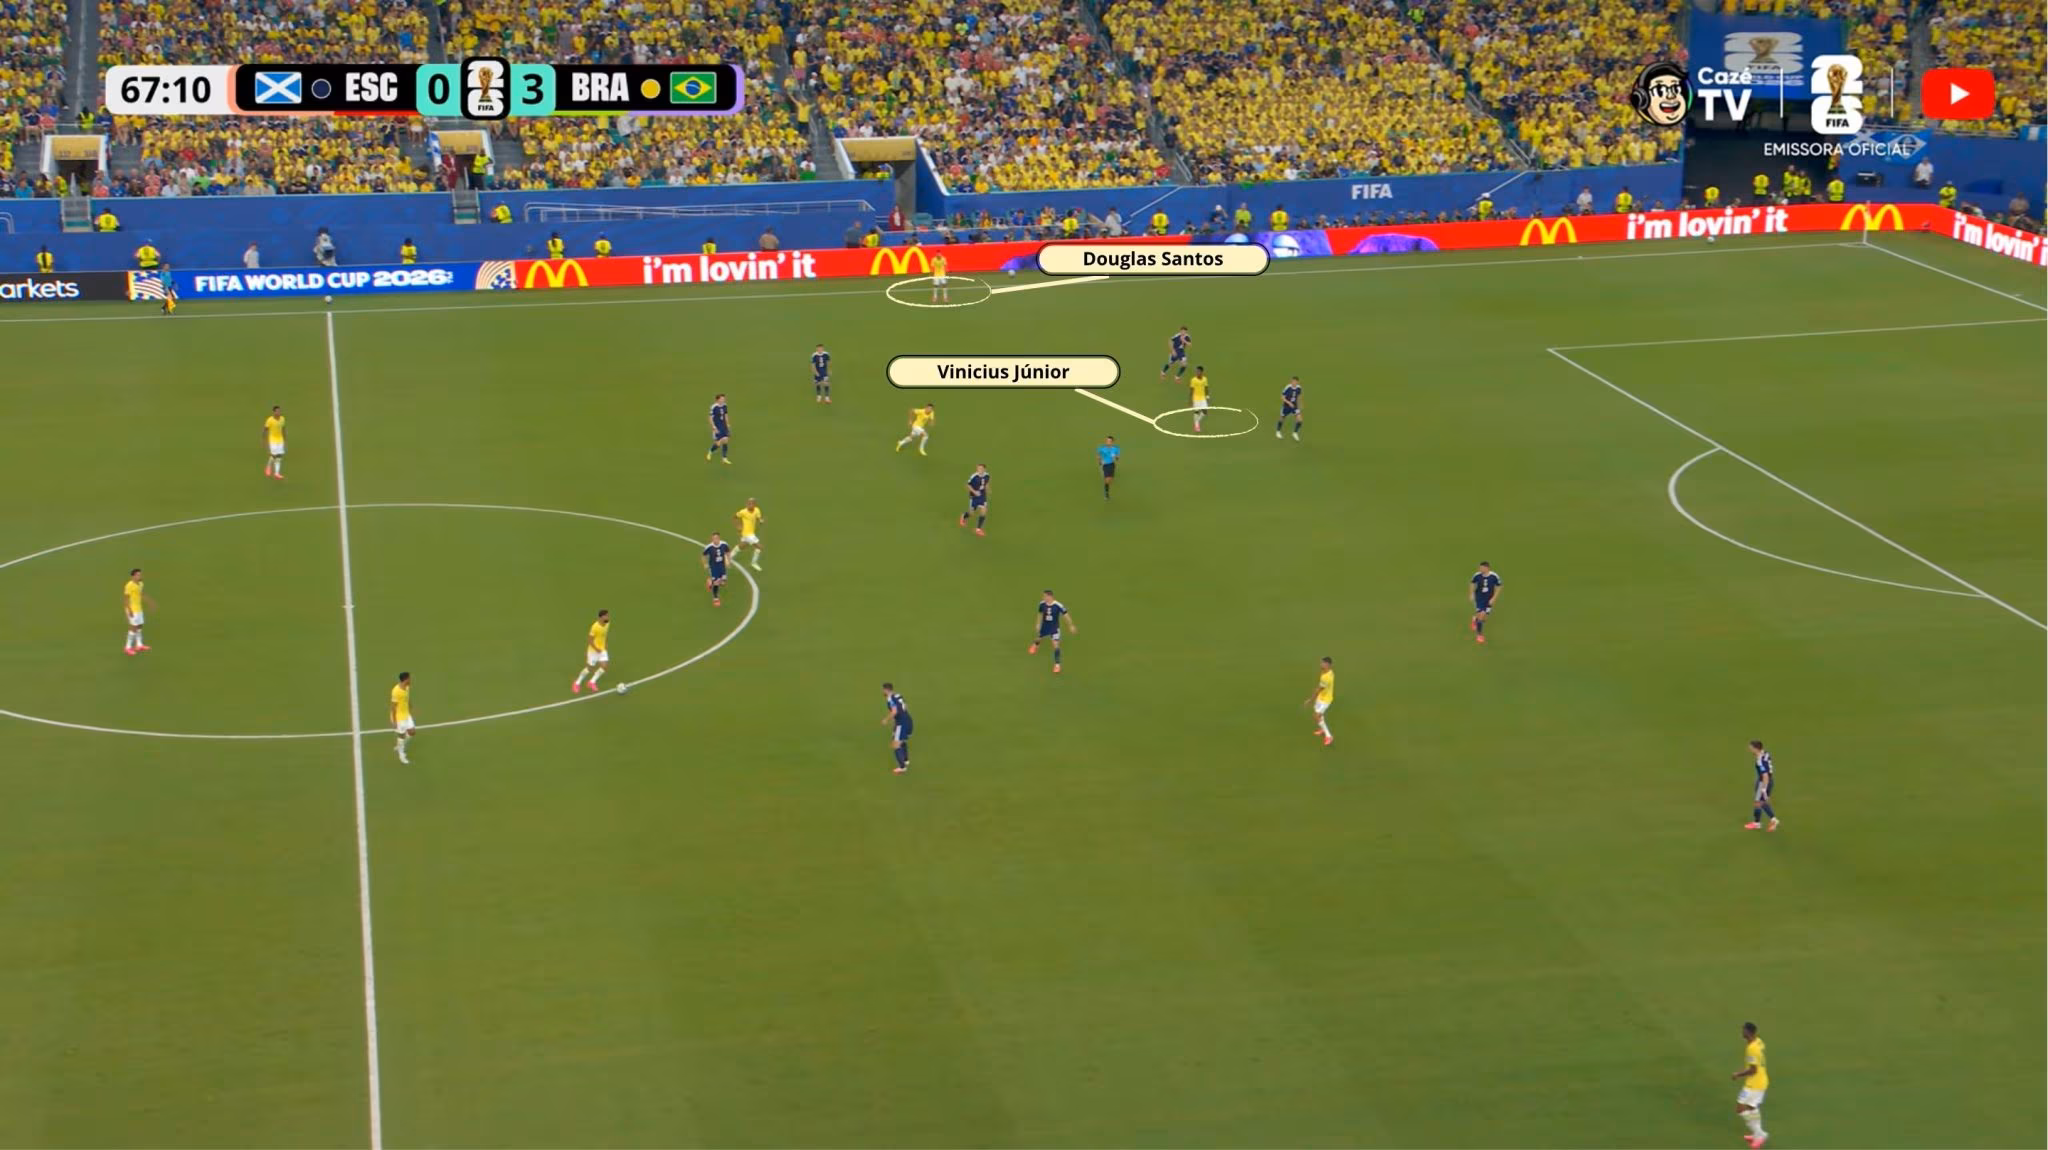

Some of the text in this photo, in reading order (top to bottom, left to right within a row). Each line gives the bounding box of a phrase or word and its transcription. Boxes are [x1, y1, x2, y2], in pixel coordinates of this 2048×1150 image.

[1351, 183, 1393, 200] FIFA
[1764, 205, 1789, 233] it
[792, 250, 816, 279] it
[0, 278, 80, 299] arkets
[195, 275, 244, 293] FIFA
[245, 272, 325, 291] WORLD
[327, 271, 371, 288] CUP
[373, 268, 449, 287] 2026
